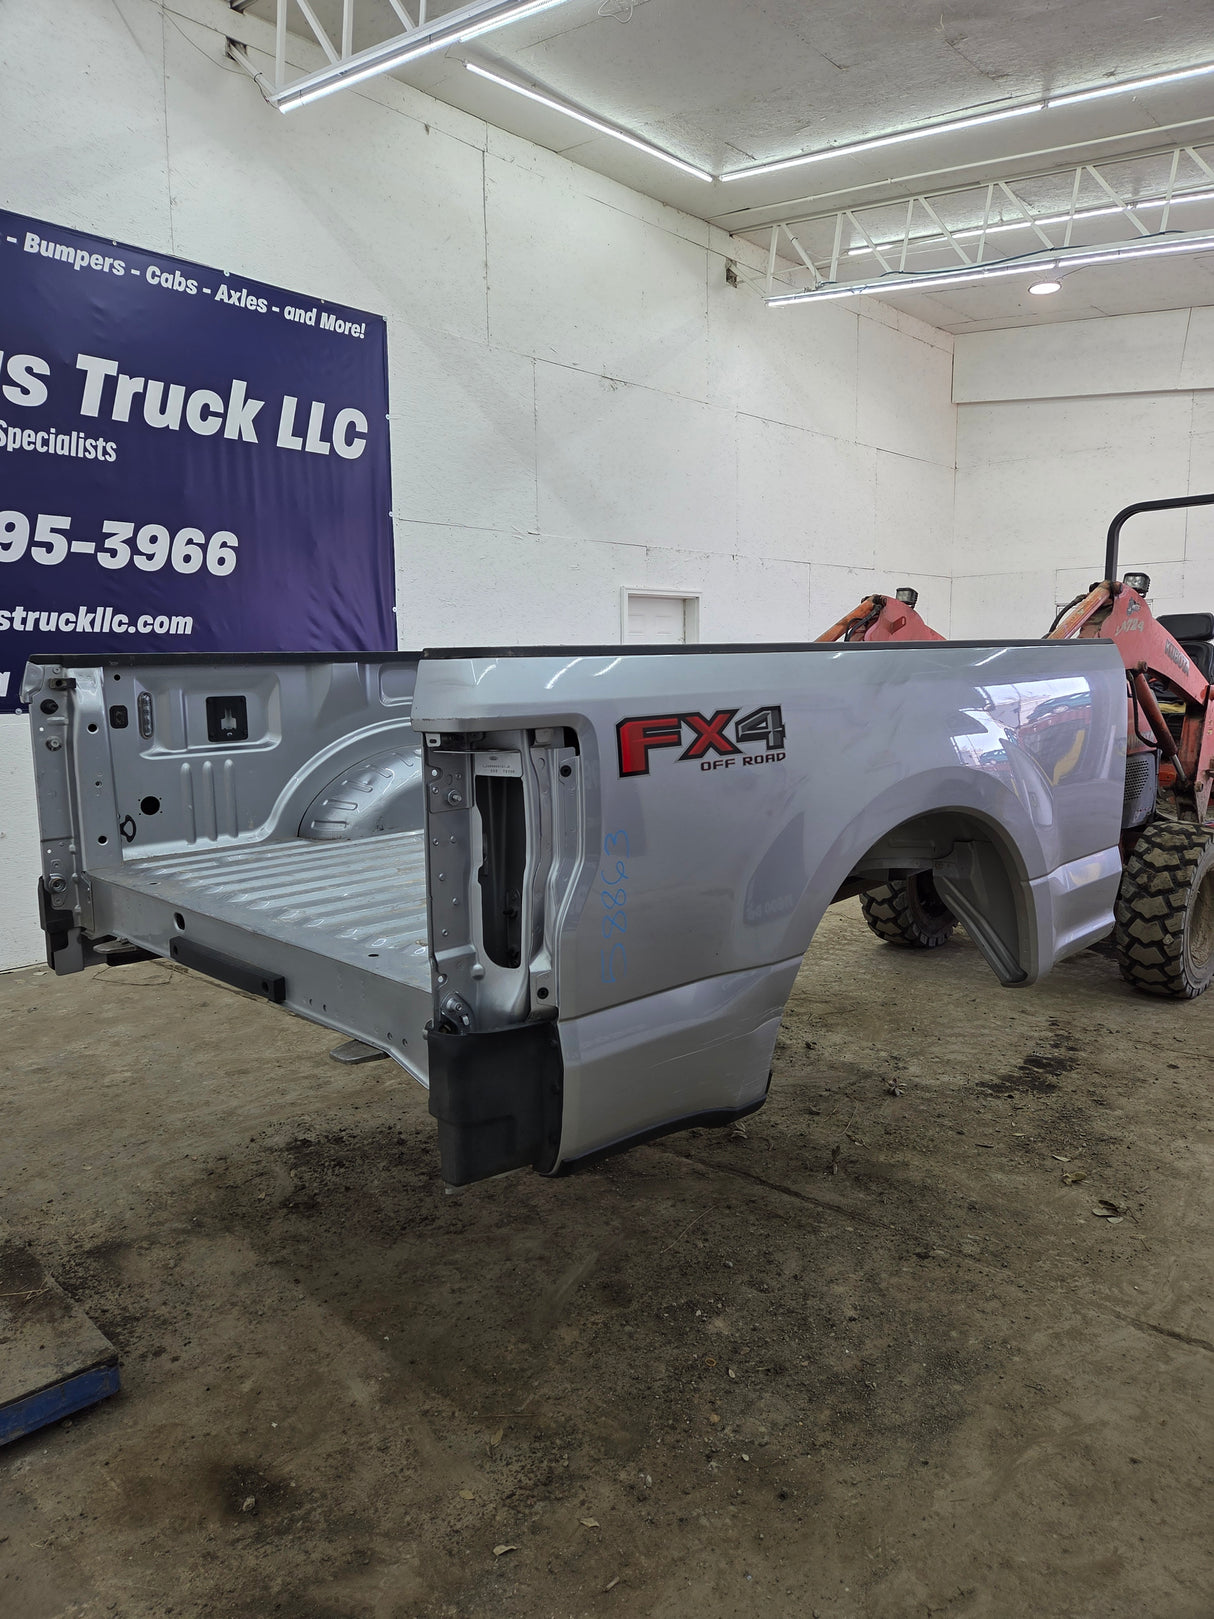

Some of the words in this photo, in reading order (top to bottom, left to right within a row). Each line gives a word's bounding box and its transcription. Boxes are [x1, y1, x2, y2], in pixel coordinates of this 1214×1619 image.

[24, 232, 125, 276] Bumpers
[145, 265, 198, 295] Cabs
[215, 284, 267, 313] Axles
[284, 306, 317, 326] and
[320, 312, 366, 339] More!
[0, 350, 51, 407] s
[76, 353, 265, 444] Truck
[276, 395, 369, 460] LLC
[0, 510, 239, 577] 95-3966
[0, 606, 193, 635] struckllc.com
[616, 705, 786, 778] FX4
[700, 758, 736, 771] OFF
[742, 752, 786, 766] ROAD
